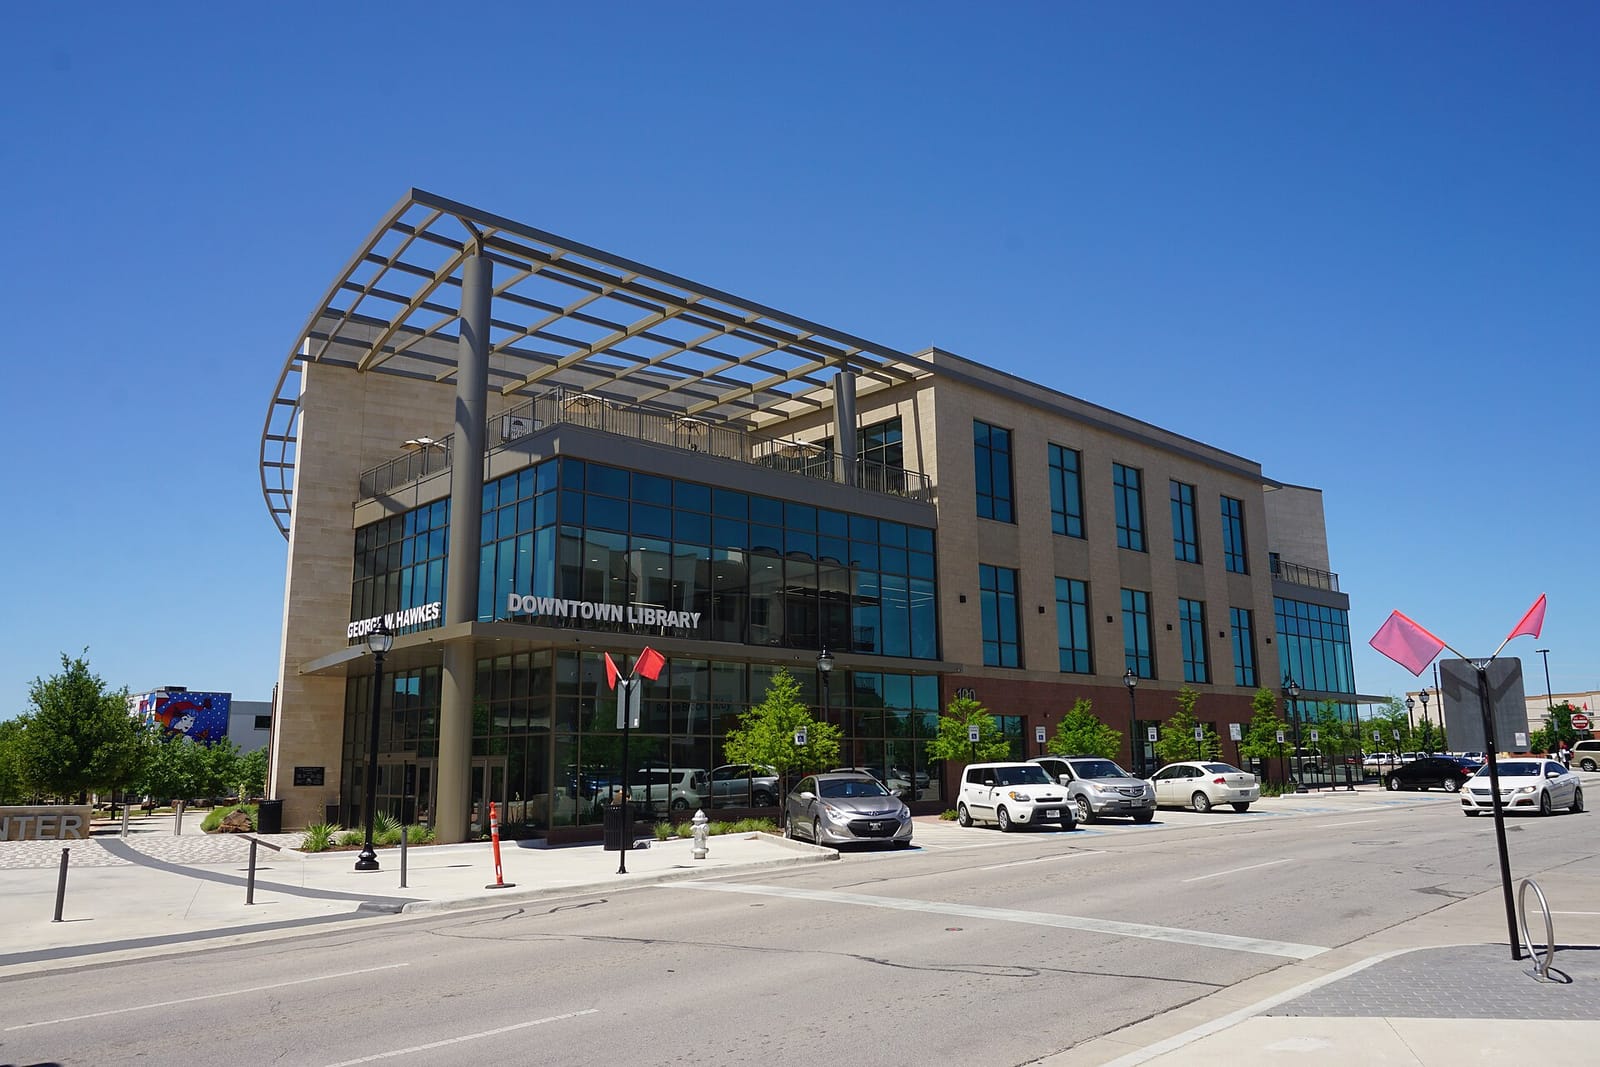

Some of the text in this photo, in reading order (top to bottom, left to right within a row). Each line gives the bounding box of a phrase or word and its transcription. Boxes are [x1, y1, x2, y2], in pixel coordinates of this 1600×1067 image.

[396, 601, 442, 628] HAWKES
[507, 593, 702, 629] DOWNTOWN LIBRARY
